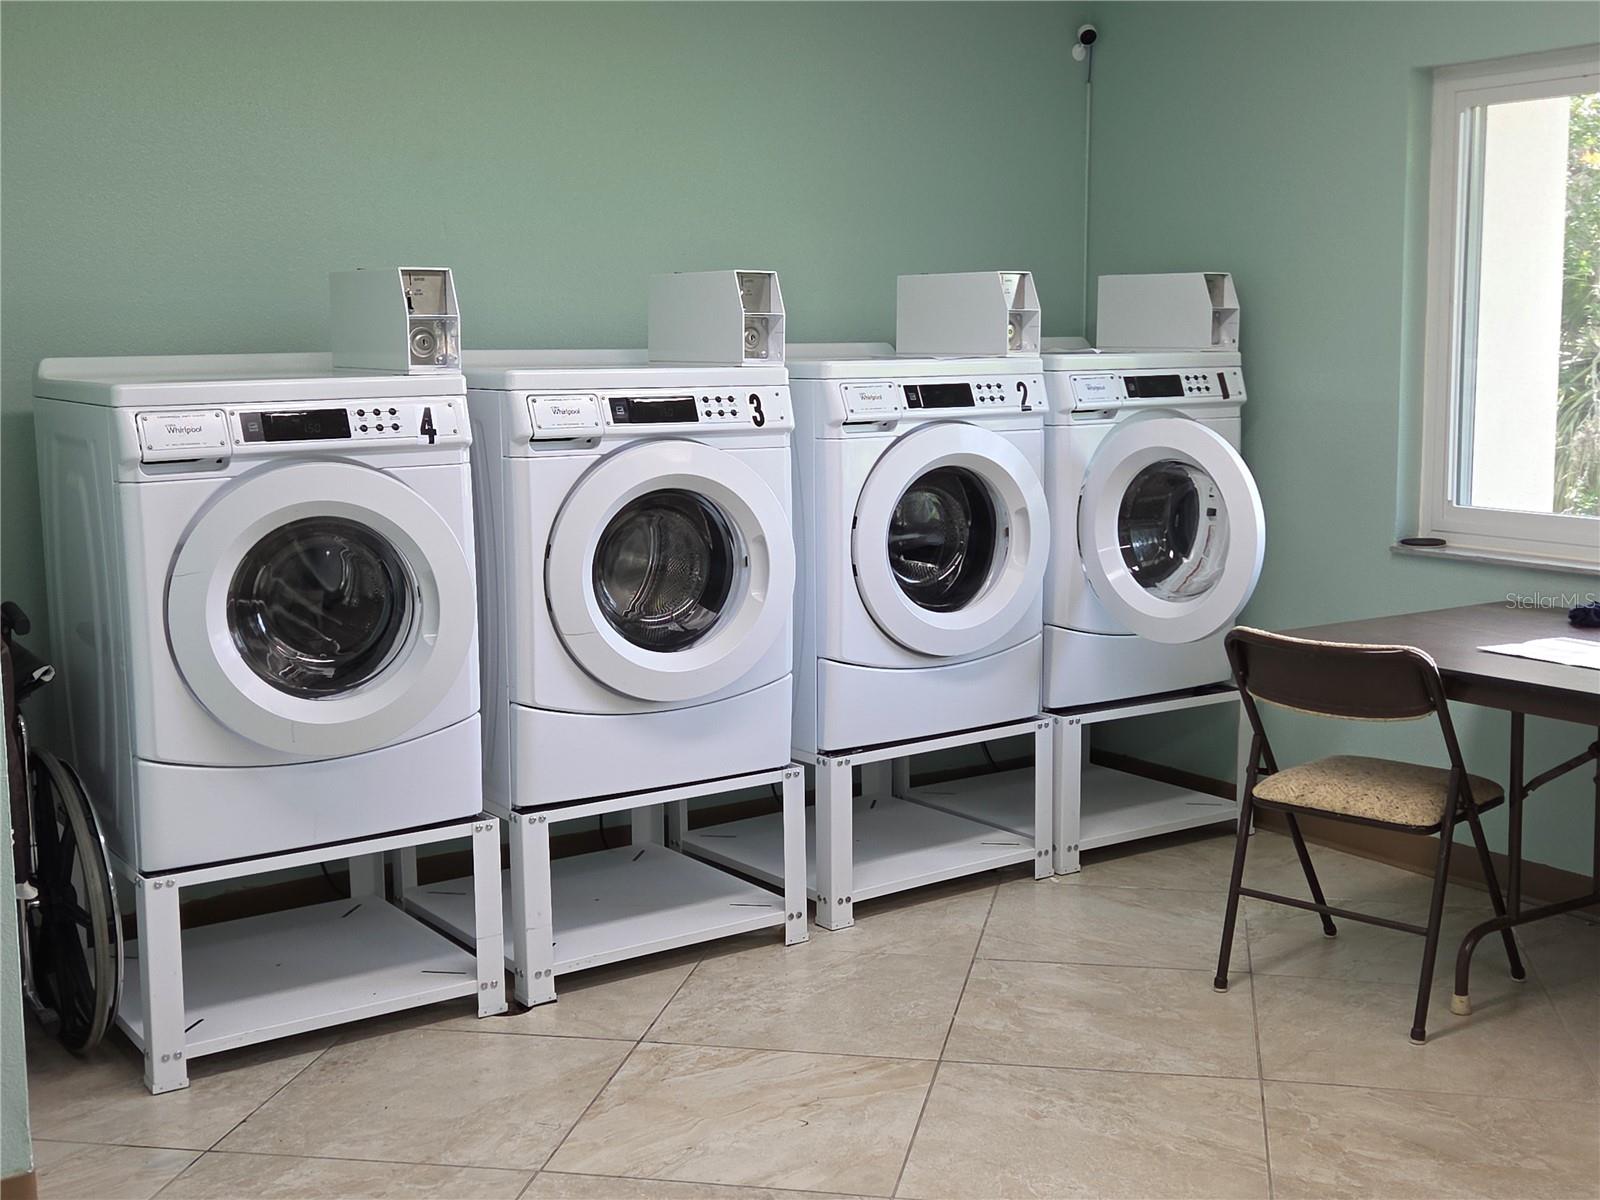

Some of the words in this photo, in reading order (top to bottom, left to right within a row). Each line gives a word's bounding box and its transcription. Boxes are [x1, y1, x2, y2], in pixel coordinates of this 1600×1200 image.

[749, 393, 765, 427] 3
[1016, 381, 1033, 411] 2
[166, 425, 202, 434] Whirlpool
[420, 407, 437, 444] 4
